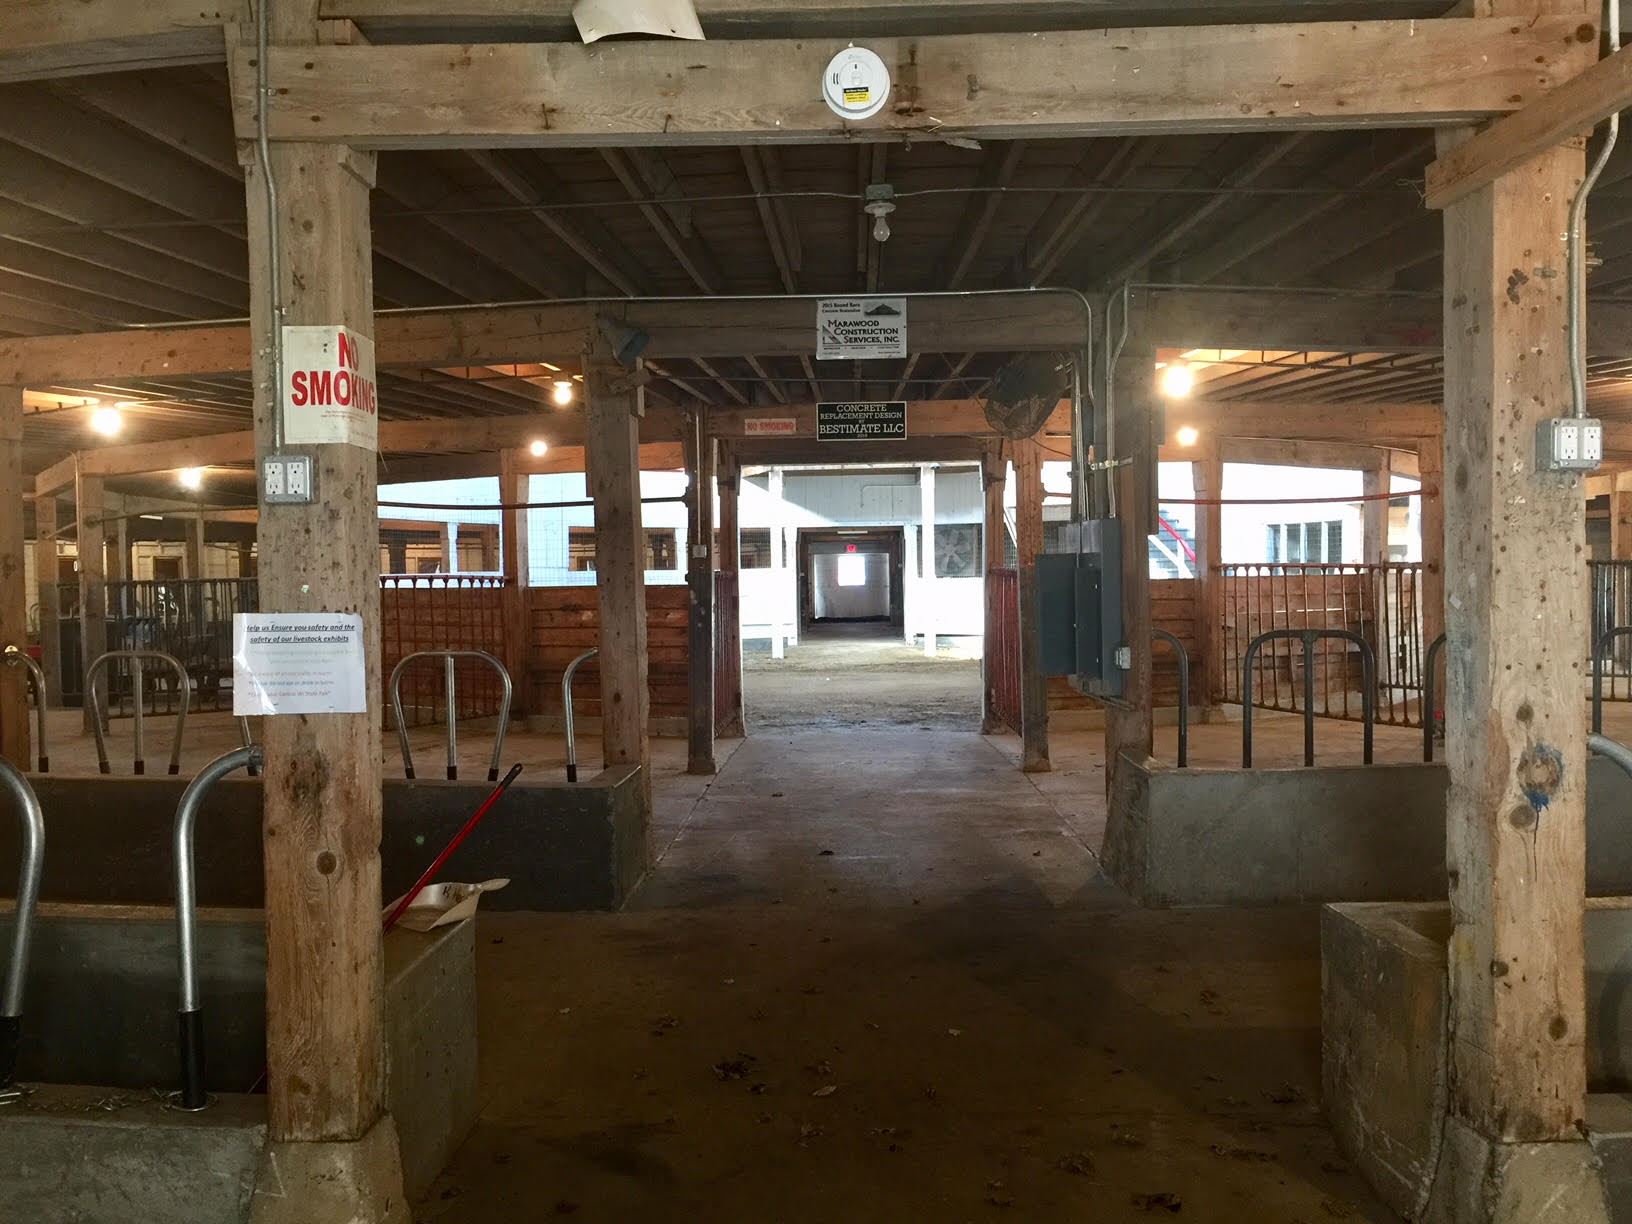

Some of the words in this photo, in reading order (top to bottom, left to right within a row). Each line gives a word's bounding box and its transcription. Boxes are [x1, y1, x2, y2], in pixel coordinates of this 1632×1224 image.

[338, 332, 360, 372] NO
[292, 370, 376, 415] SMOKING
[836, 404, 887, 412] CONCRETE
[747, 422, 758, 431] NO
[760, 422, 794, 431] SMOKING
[820, 424, 880, 434] BESTIMATE
[883, 424, 904, 432] LLC
